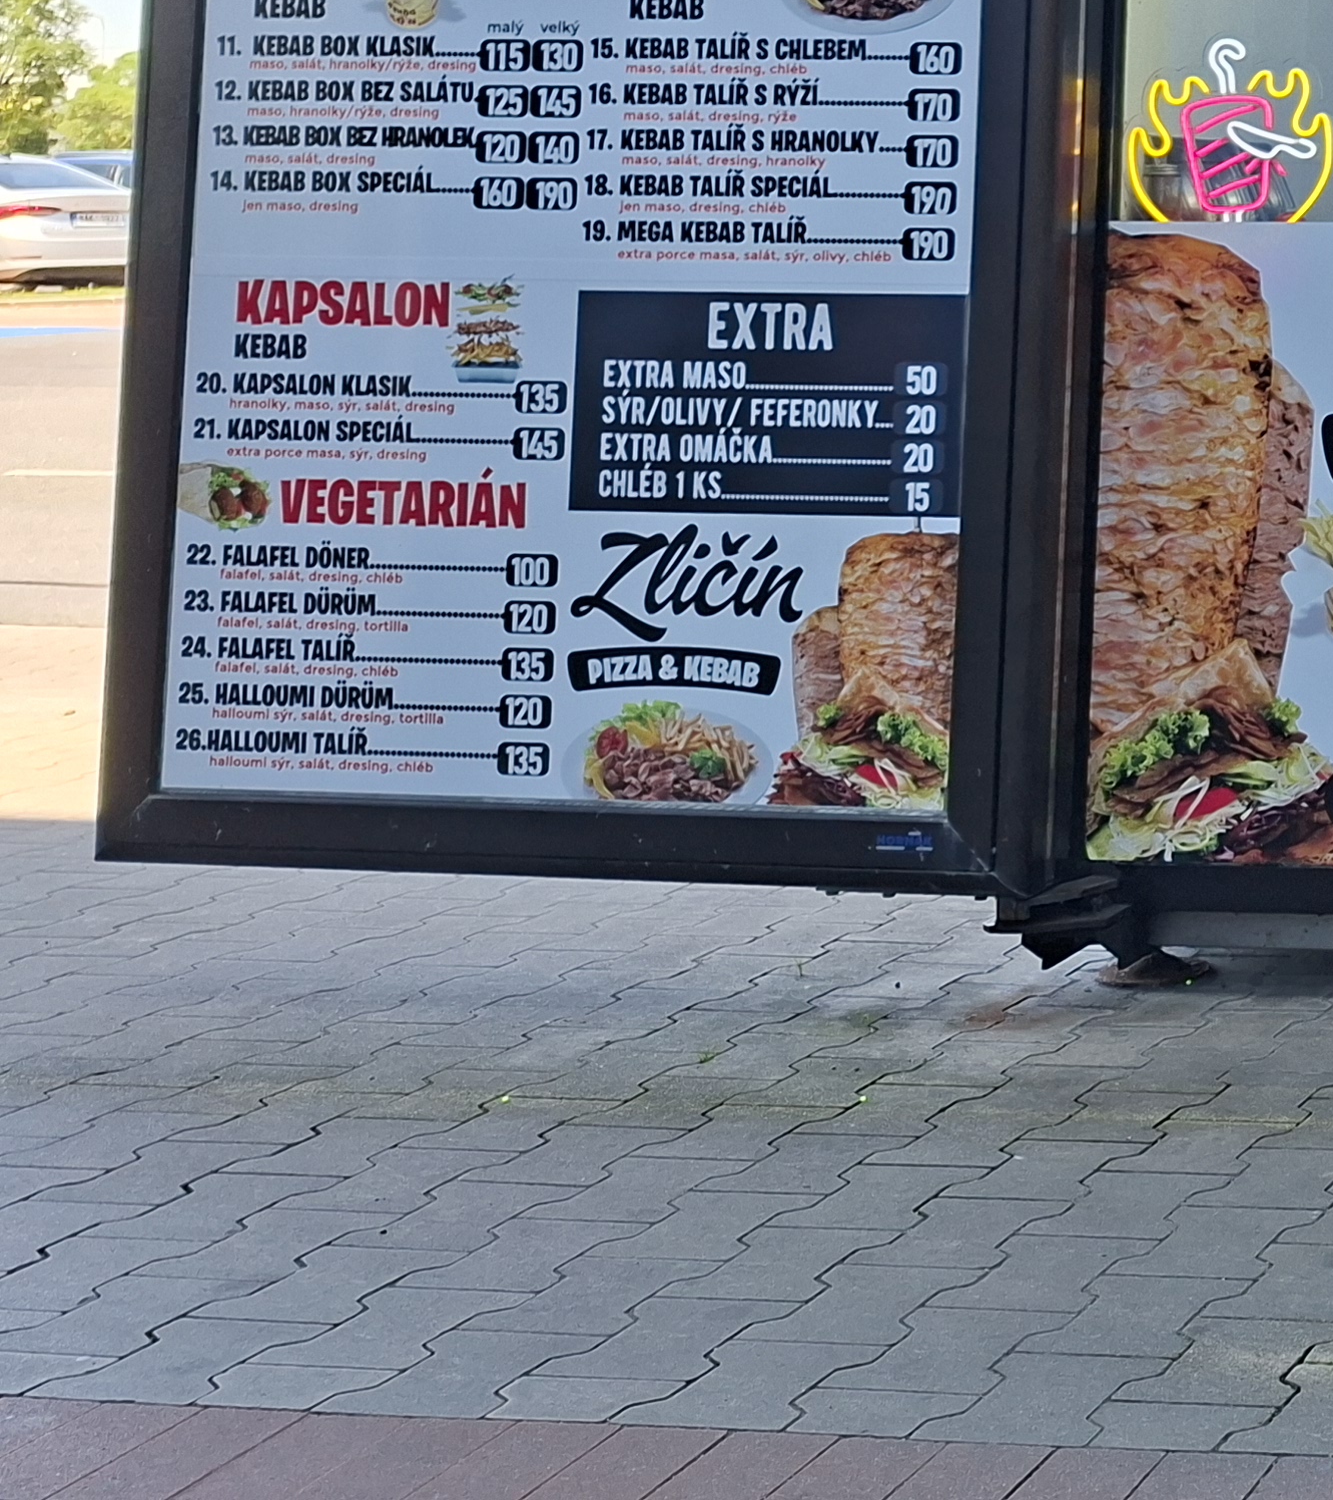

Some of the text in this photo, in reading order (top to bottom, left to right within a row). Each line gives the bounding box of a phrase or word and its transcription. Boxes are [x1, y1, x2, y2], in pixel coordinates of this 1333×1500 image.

[488, 20, 579, 36] malý velký
[217, 36, 241, 56] 11.
[252, 36, 314, 56] KEBAB
[320, 36, 360, 56] BOX
[485, 42, 524, 69] 115
[542, 42, 578, 69] 130
[589, 84, 616, 105] 16.
[623, 84, 687, 106] KEBAB
[693, 77, 747, 106] TALÍŘ
[754, 84, 766, 106] S
[915, 92, 952, 120] 170
[237, 280, 450, 327] KAPSALON
[707, 302, 833, 350] EXTRA
[235, 334, 307, 359] KEBAB
[196, 373, 227, 394] 20.
[233, 373, 335, 396] KAPSALON
[519, 384, 560, 411] 135
[603, 360, 674, 389] EXTRA
[906, 366, 936, 395] 50
[905, 405, 935, 435] 20
[600, 434, 671, 461] EXTRA
[903, 444, 933, 473] 20
[280, 468, 526, 529] VEGETARIÁN
[599, 464, 666, 498] CHLÉB
[676, 472, 684, 499] 1
[906, 482, 929, 512] 15
[186, 544, 217, 565] 22.
[223, 545, 299, 567] FALAFEL
[511, 557, 550, 585] 100
[571, 524, 803, 642] Zličín
[588, 655, 761, 688] PIZZA & KEBAB
[505, 745, 542, 774] 135
